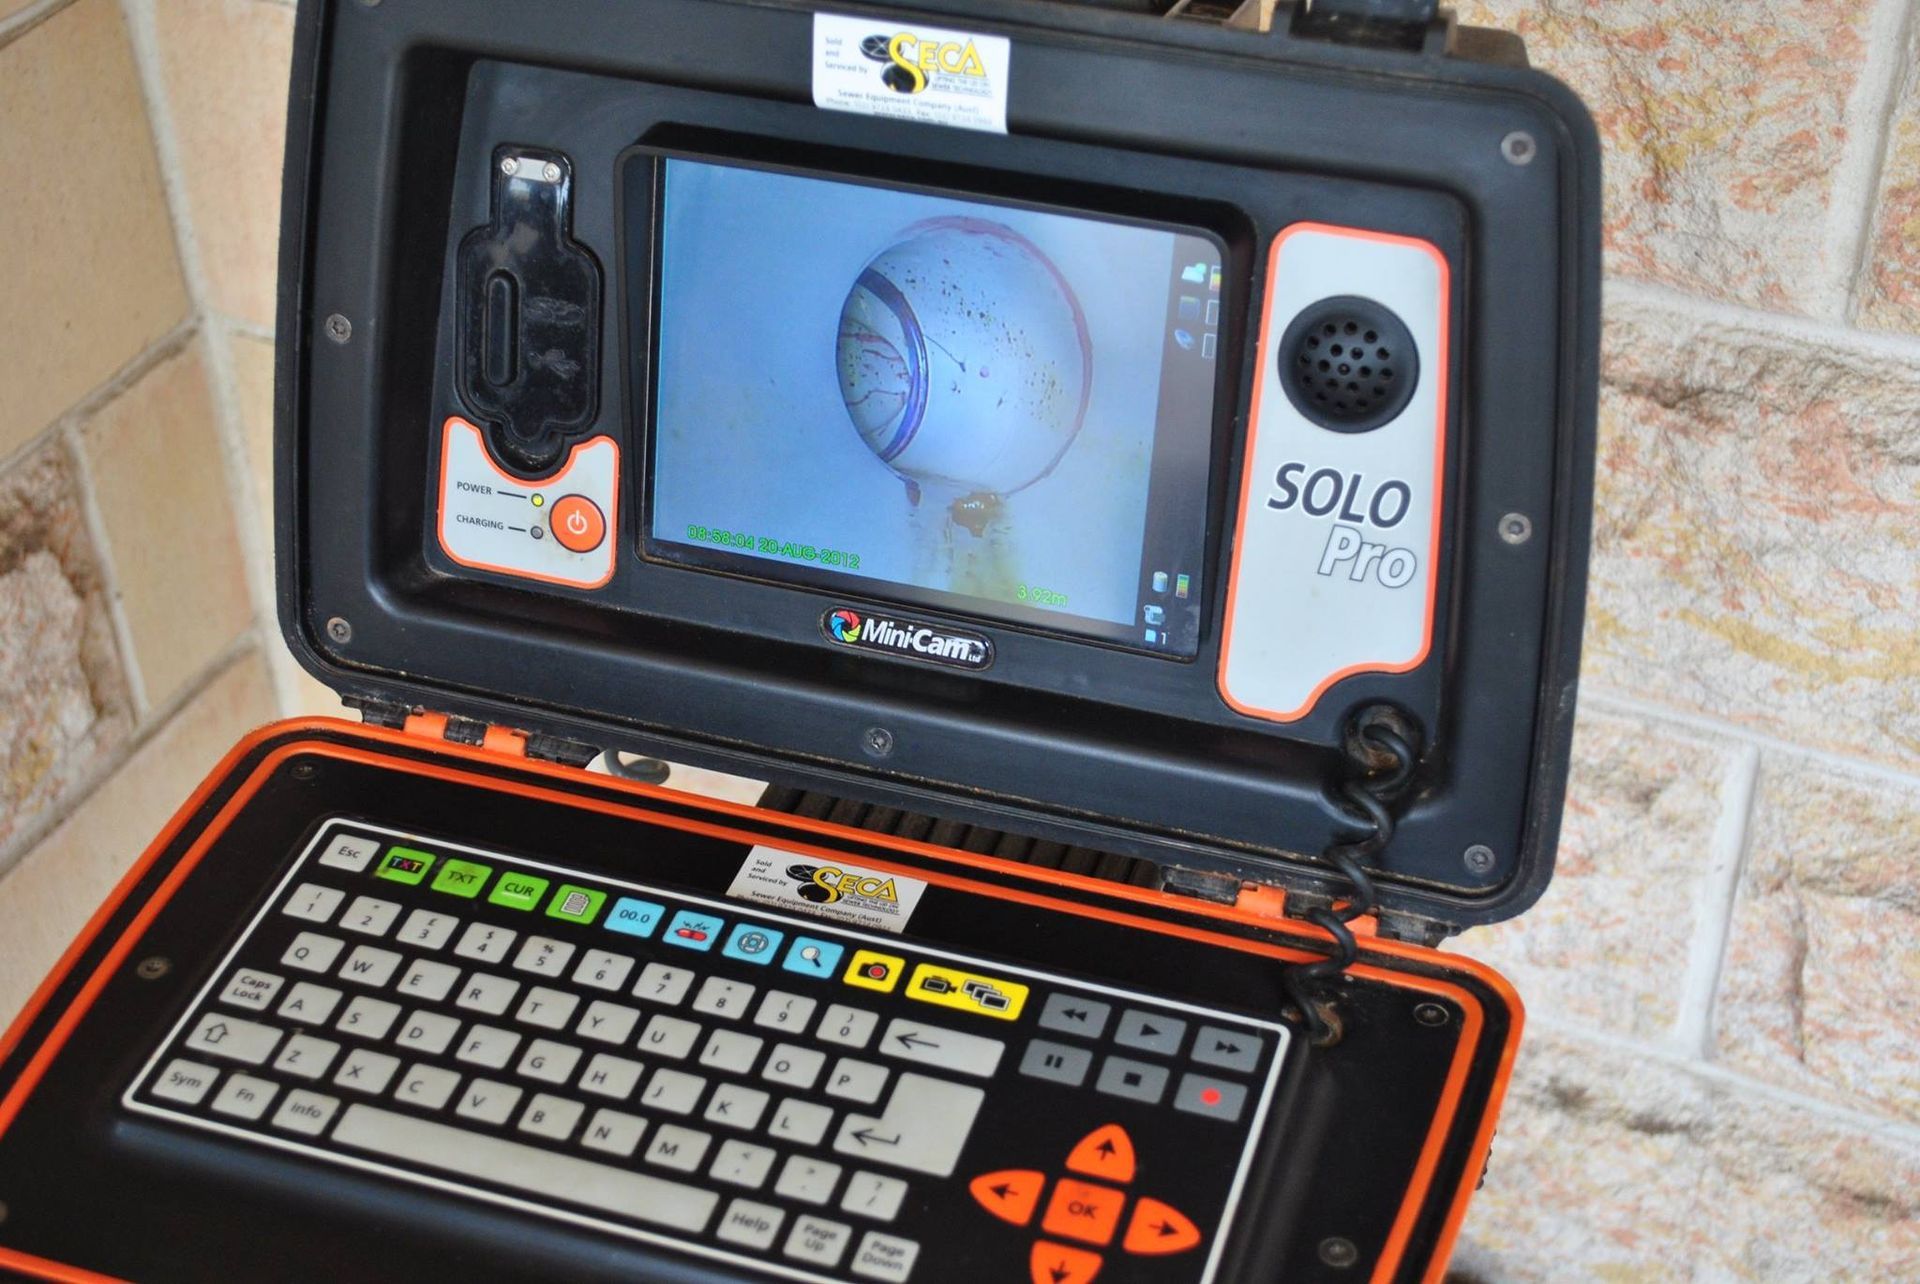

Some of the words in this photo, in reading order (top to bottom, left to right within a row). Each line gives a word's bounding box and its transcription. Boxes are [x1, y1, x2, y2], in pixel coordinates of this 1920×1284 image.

[888, 32, 986, 94] SECA
[838, 89, 862, 99] Sewer
[865, 92, 910, 105] Equipment
[913, 98, 952, 111] Company
[456, 481, 492, 495] POWER
[1267, 462, 1412, 529] SOLO
[456, 514, 504, 530] CHARGING
[687, 524, 754, 550] 08:58:04
[758, 537, 860, 570] 20-AUG-2012
[1317, 524, 1417, 589] Pro
[1016, 584, 1069, 608] 3.92m
[338, 846, 361, 859] Esc
[391, 857, 422, 872] TXT
[756, 859, 772, 868] Sold
[448, 871, 477, 884] TXT
[751, 867, 766, 875] and
[748, 873, 777, 884] Serviced
[778, 879, 787, 887] by
[812, 866, 898, 904] SECA
[504, 881, 534, 897] CUR
[307, 903, 314, 912] 1
[752, 891, 774, 900] Sewer
[777, 894, 819, 911] Equipment
[820, 903, 856, 918] Company
[858, 912, 882, 923] (Aust)
[361, 915, 372, 926] 2
[619, 909, 650, 924] 00.0
[419, 929, 429, 939] 3
[294, 947, 310, 961] Q
[477, 943, 488, 953] 4
[353, 960, 373, 974] W
[536, 956, 547, 967] 5
[410, 974, 423, 986] E
[595, 970, 606, 980] 6
[241, 975, 271, 990] Caps
[656, 983, 666, 994] 7
[232, 987, 262, 1001] Lock
[469, 988, 482, 1001] R
[288, 999, 304, 1011] A
[531, 1002, 543, 1014] T
[716, 997, 727, 1009] 8
[348, 1012, 361, 1024] S
[591, 1016, 604, 1028] Y
[777, 1012, 788, 1022] 9
[408, 1027, 424, 1039] D
[651, 1031, 666, 1044] U
[469, 1041, 481, 1053] F
[711, 1045, 719, 1056] I
[287, 1051, 301, 1063] Z
[530, 1056, 545, 1069] G
[347, 1065, 363, 1078] X
[775, 1060, 790, 1073] O
[169, 1071, 202, 1088] Sym
[591, 1071, 607, 1084] H
[837, 1074, 850, 1086] P
[409, 1080, 424, 1093] C
[652, 1086, 664, 1098] J
[236, 1088, 255, 1102] Fn
[471, 1095, 487, 1107] V
[290, 1103, 322, 1118] Info
[716, 1101, 732, 1114] K
[531, 1111, 545, 1123] B
[781, 1116, 790, 1129] L
[595, 1126, 611, 1140] N
[658, 1142, 679, 1156] M
[1068, 1201, 1098, 1220] OK
[732, 1212, 770, 1232] Help
[804, 1223, 838, 1240] Page
[804, 1238, 825, 1252] Up
[871, 1241, 905, 1257] Page
[861, 1252, 904, 1271] Down
